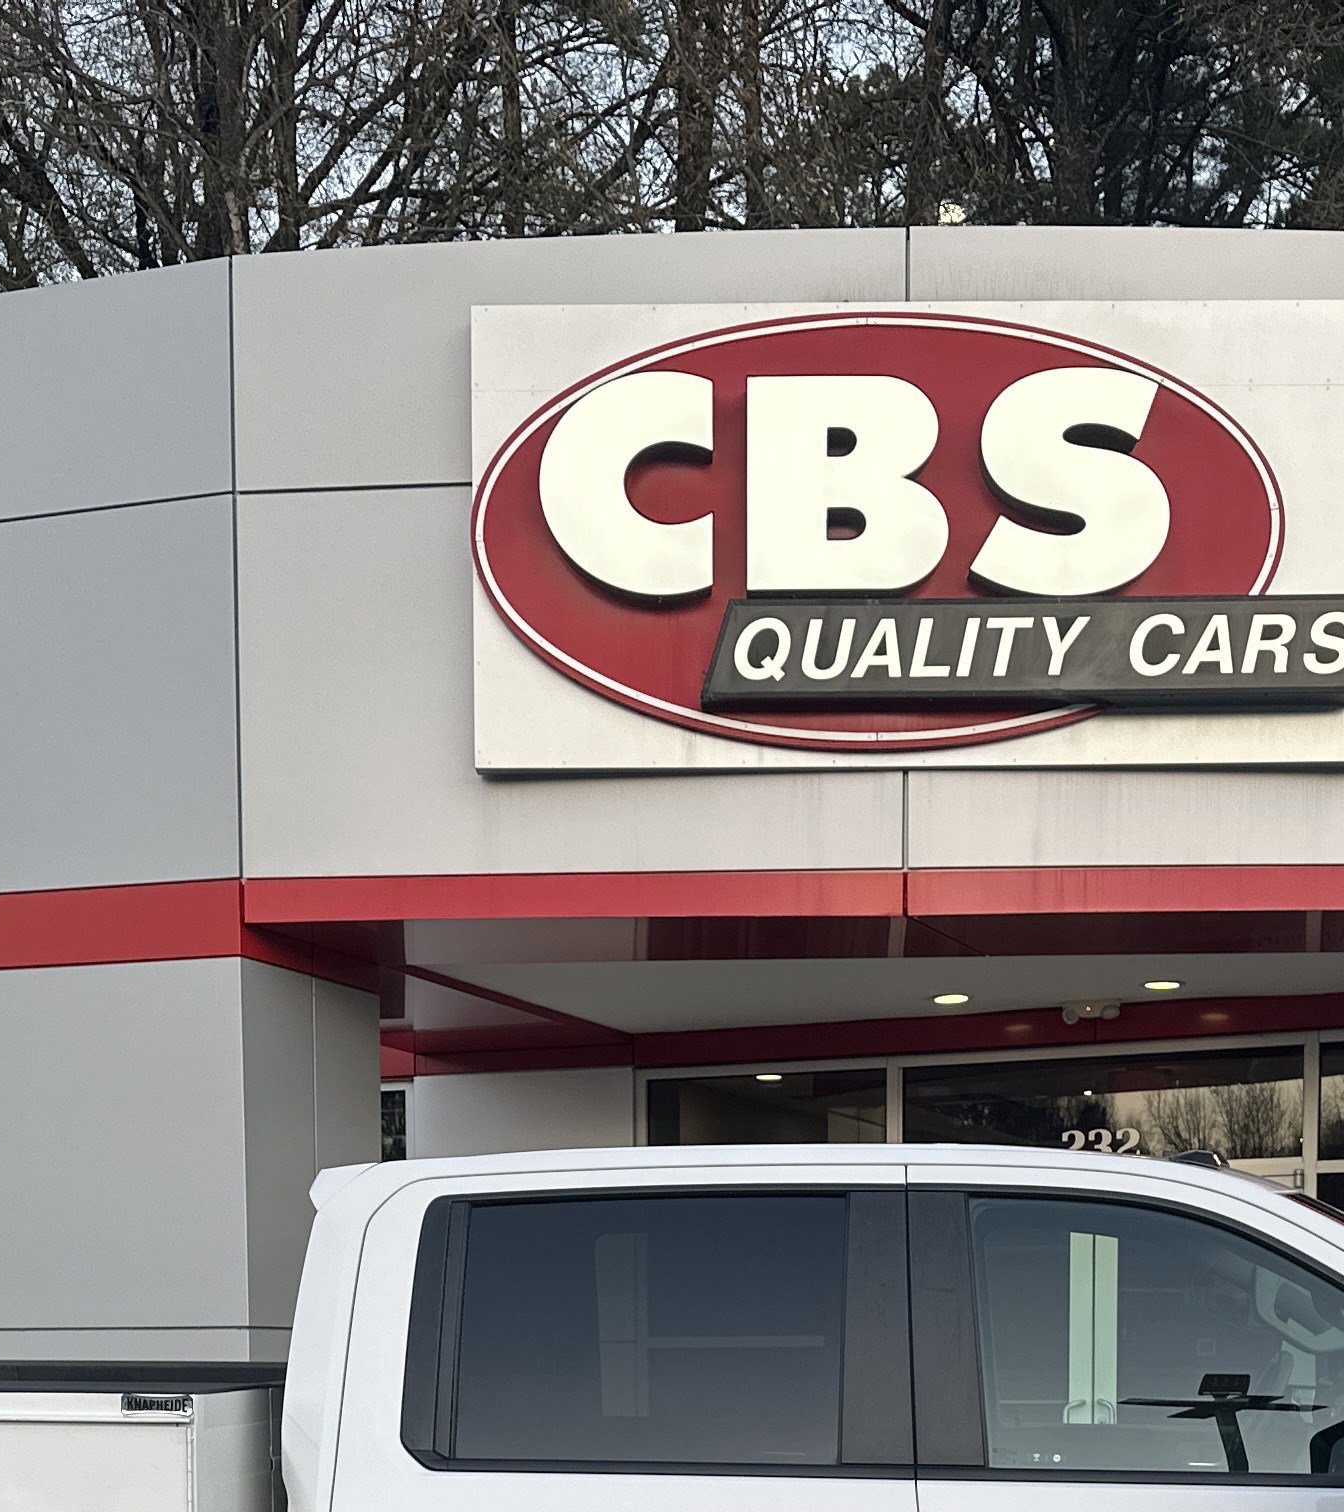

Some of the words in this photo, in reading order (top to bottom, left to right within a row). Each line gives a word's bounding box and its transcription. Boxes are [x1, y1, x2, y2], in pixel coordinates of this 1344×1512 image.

[539, 366, 1171, 598] CBS
[733, 616, 1090, 682] QUALITY
[1061, 1127, 1140, 1154] 232
[126, 1395, 189, 1412] KNAPHEIDE
